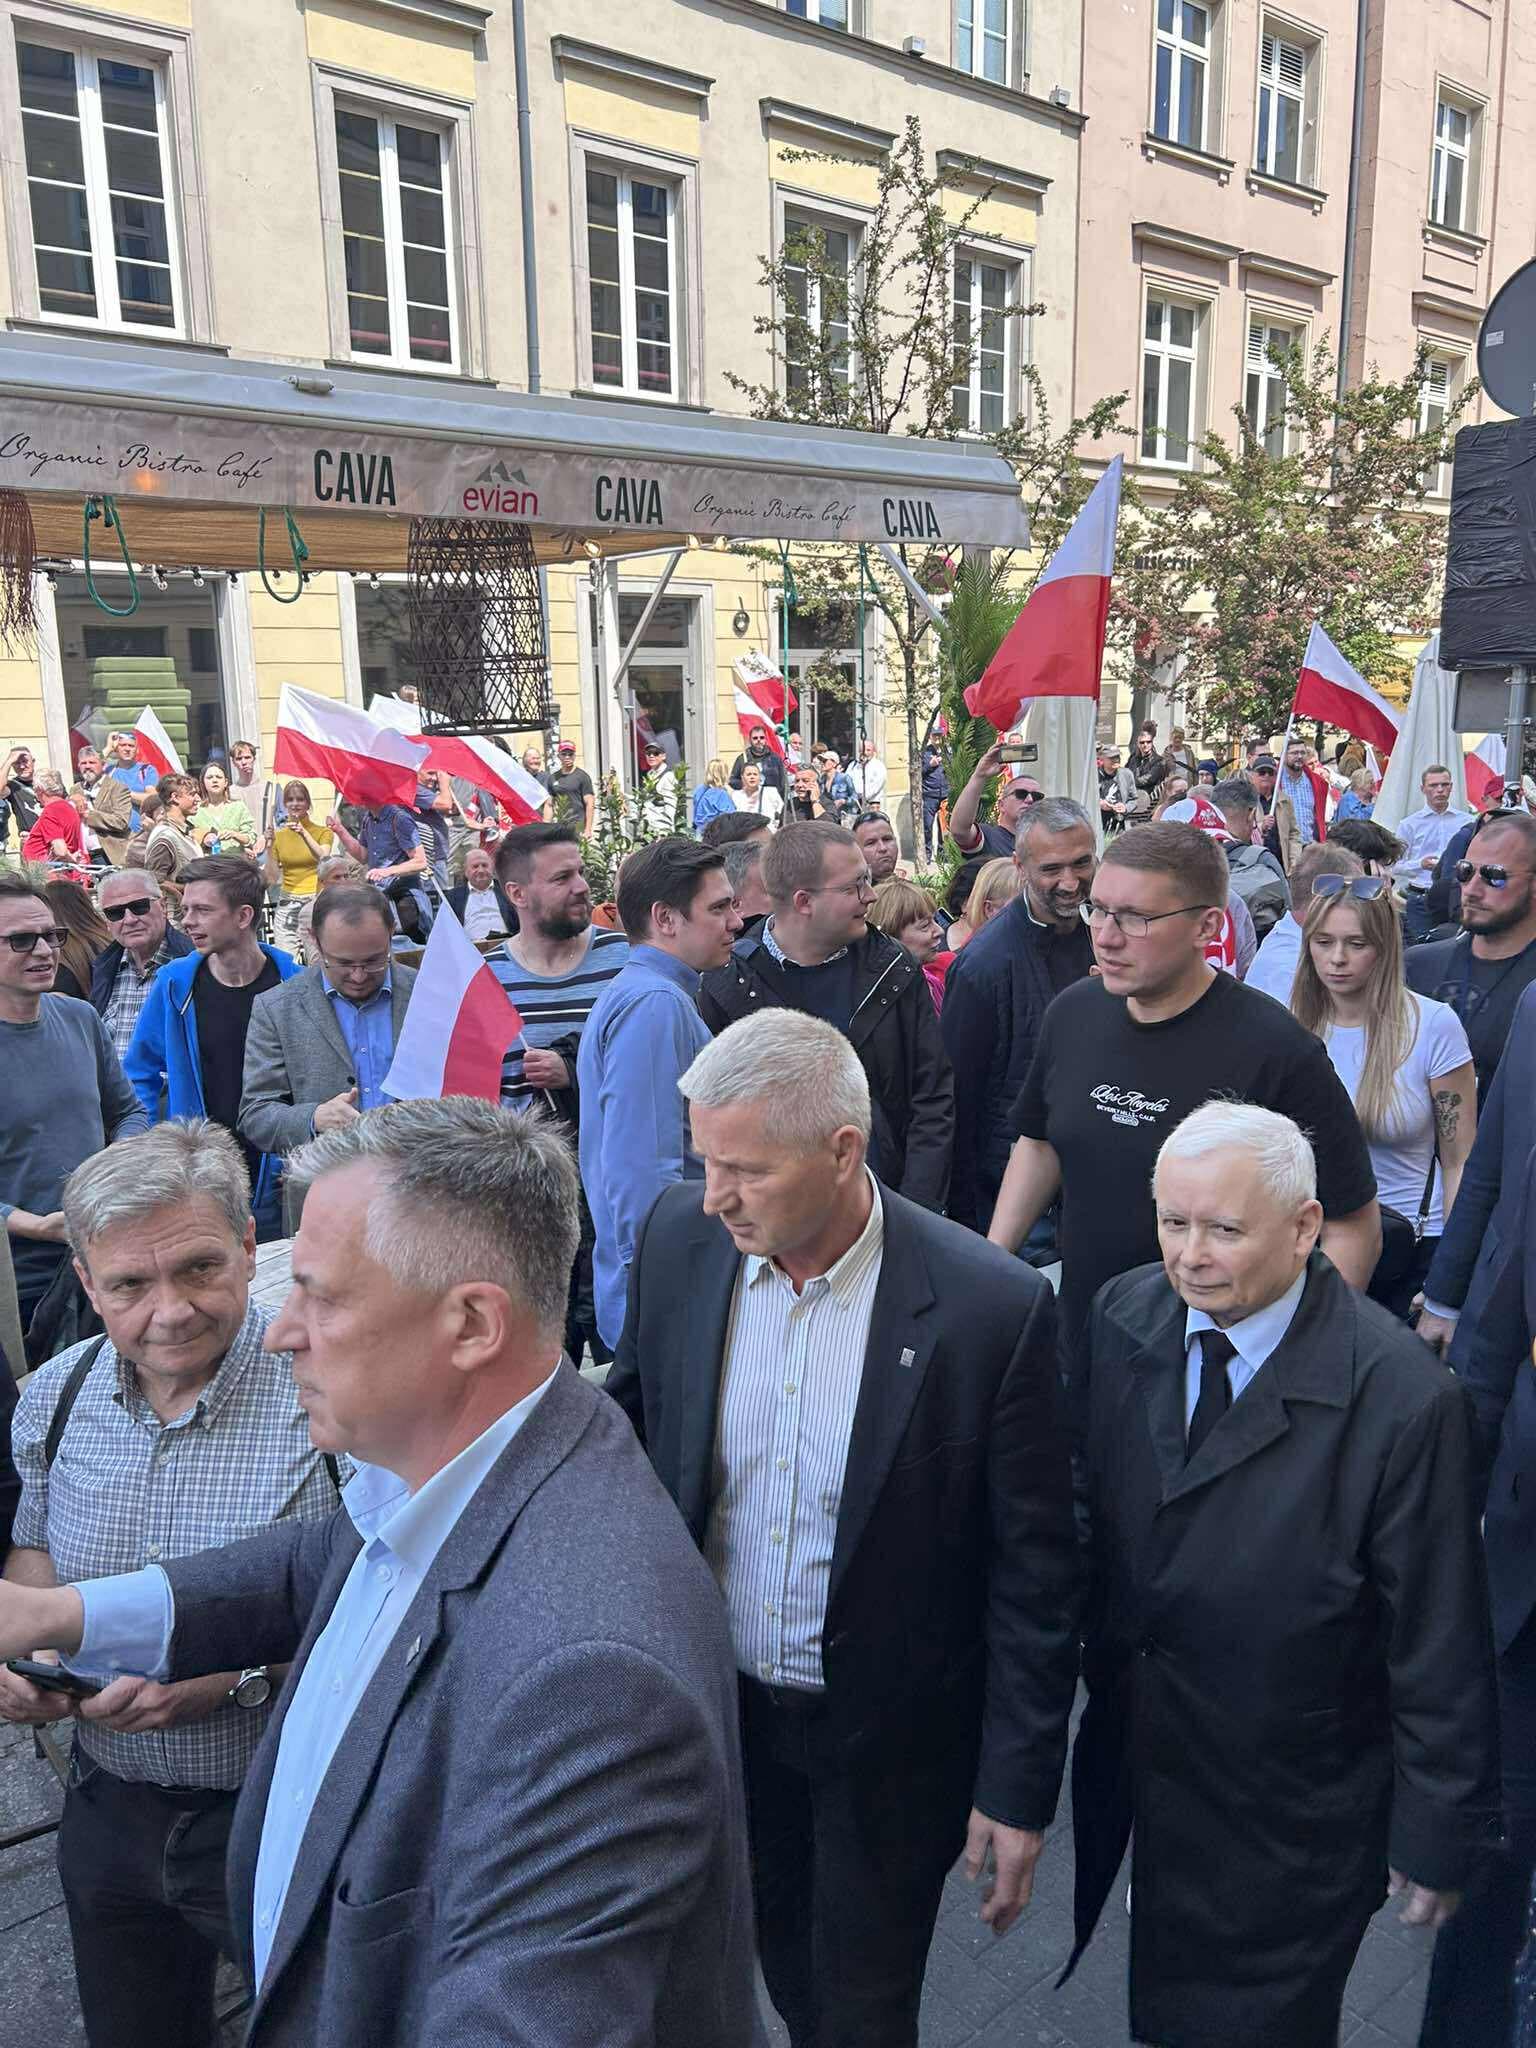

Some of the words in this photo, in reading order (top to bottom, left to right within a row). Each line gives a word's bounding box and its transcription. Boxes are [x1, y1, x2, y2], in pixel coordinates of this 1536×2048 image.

[0, 432, 108, 477] Organic
[118, 443, 208, 475] Bistro
[216, 451, 273, 489] Café
[313, 448, 397, 506] CAVA
[462, 483, 539, 516] evian
[595, 475, 664, 525] CAVA
[692, 492, 757, 527] Organic
[763, 498, 815, 521] Bistro
[821, 500, 857, 530] Café
[882, 497, 942, 538] CAVA
[1090, 1084, 1120, 1103] Los
[1117, 1091, 1169, 1112] Angeles
